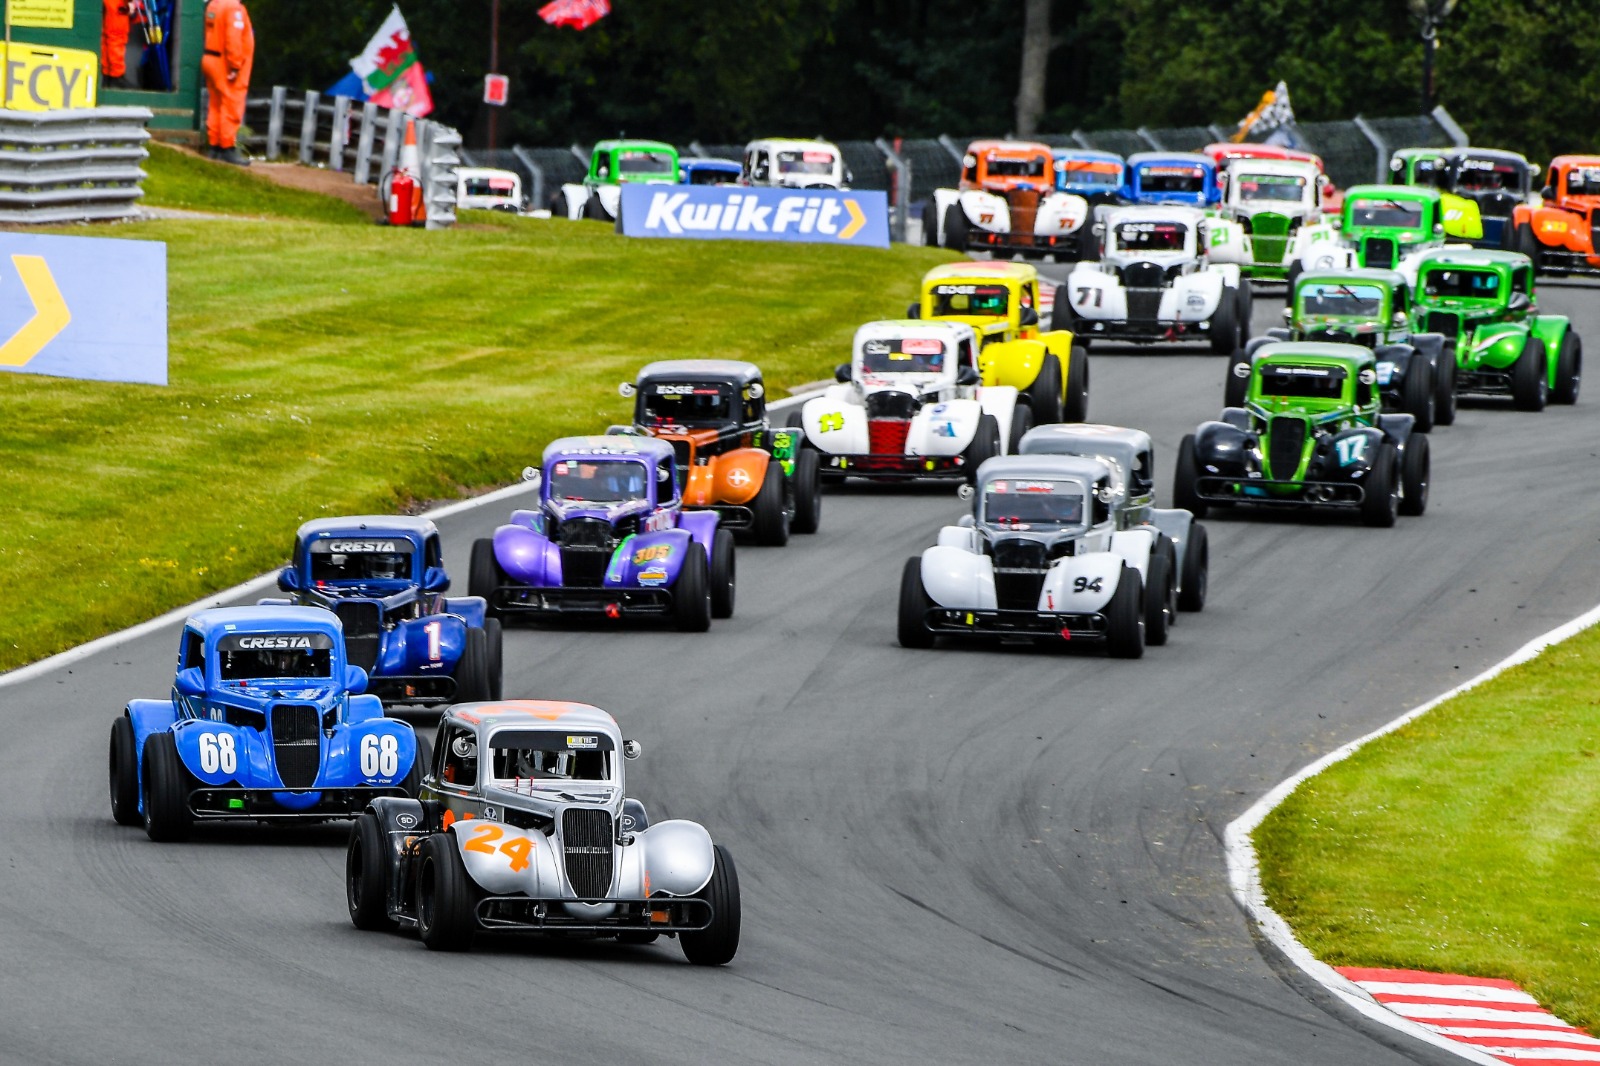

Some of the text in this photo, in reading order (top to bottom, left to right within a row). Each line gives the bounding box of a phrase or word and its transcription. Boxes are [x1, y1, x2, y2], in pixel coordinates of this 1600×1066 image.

[7, 60, 82, 108] FCY
[645, 192, 842, 234] Kwik Fit
[980, 213, 995, 224] 77
[1059, 218, 1076, 229] 77
[1211, 227, 1229, 247] 21
[937, 285, 976, 295] EDGE
[1077, 286, 1103, 308] 71
[656, 385, 694, 395] EDGE
[1335, 434, 1368, 467] 17
[329, 541, 396, 552] CRESTA
[632, 544, 673, 565] 305
[1073, 576, 1103, 593] 94
[239, 636, 311, 649] CRESTA
[424, 621, 441, 661] 1
[199, 733, 236, 774] 68
[360, 734, 398, 777] 68
[464, 824, 536, 873] 24
